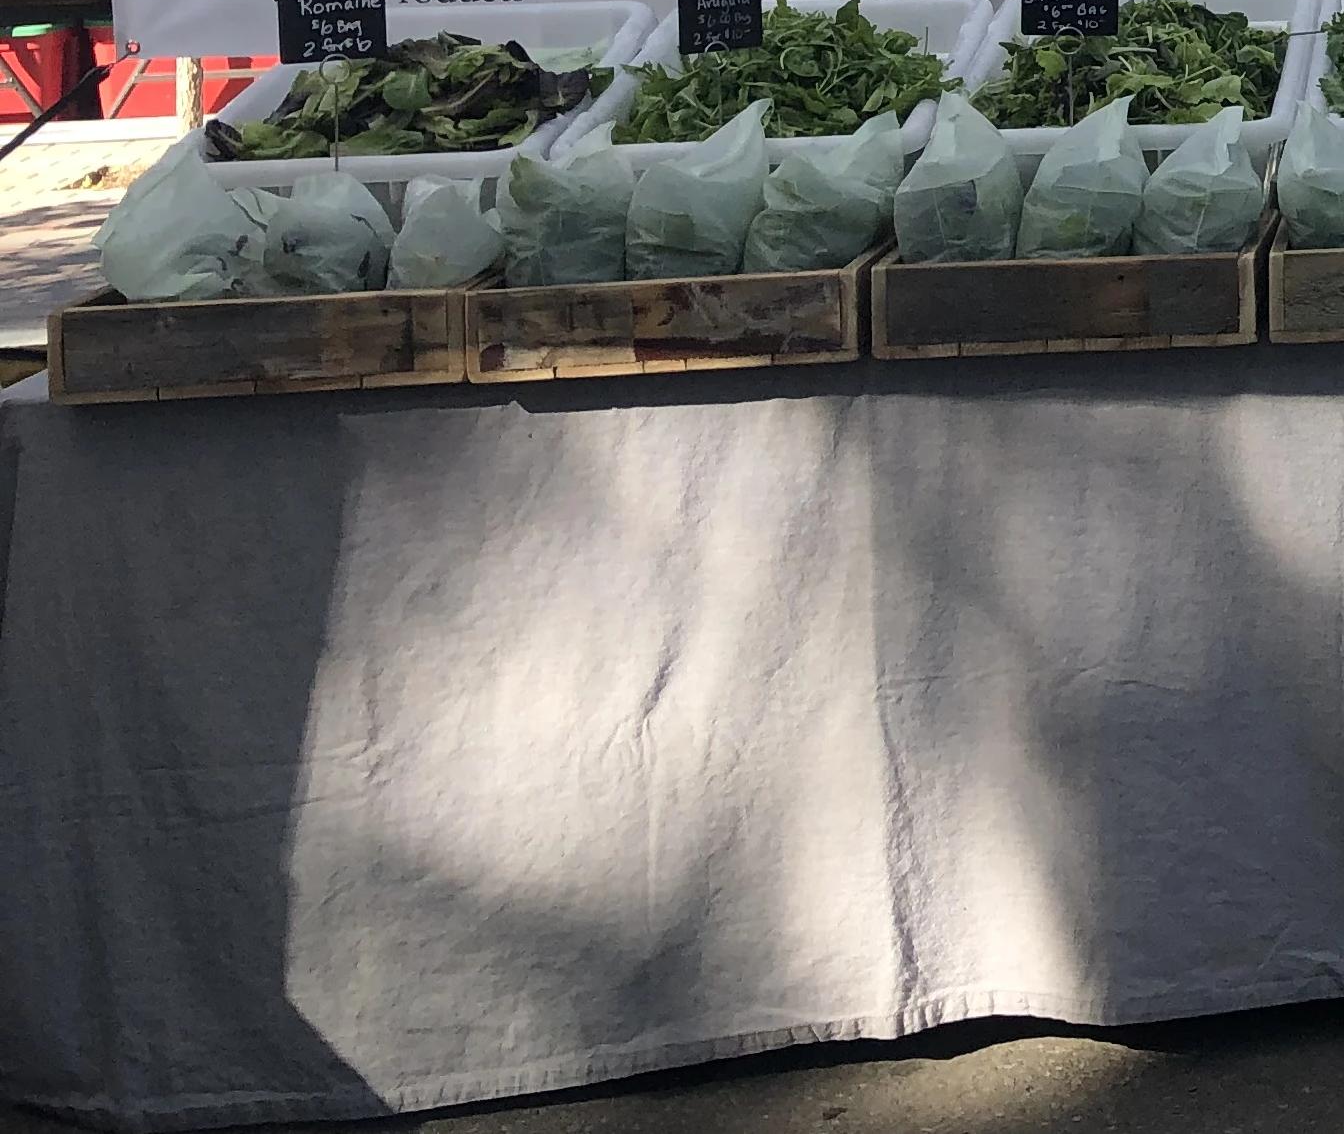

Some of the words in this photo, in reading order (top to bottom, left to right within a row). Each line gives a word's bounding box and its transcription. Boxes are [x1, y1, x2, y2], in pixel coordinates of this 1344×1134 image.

[1077, 2, 1108, 16] BAG
[1037, 20, 1047, 30] 2
[694, 32, 702, 46] 2
[303, 41, 316, 58] 2
